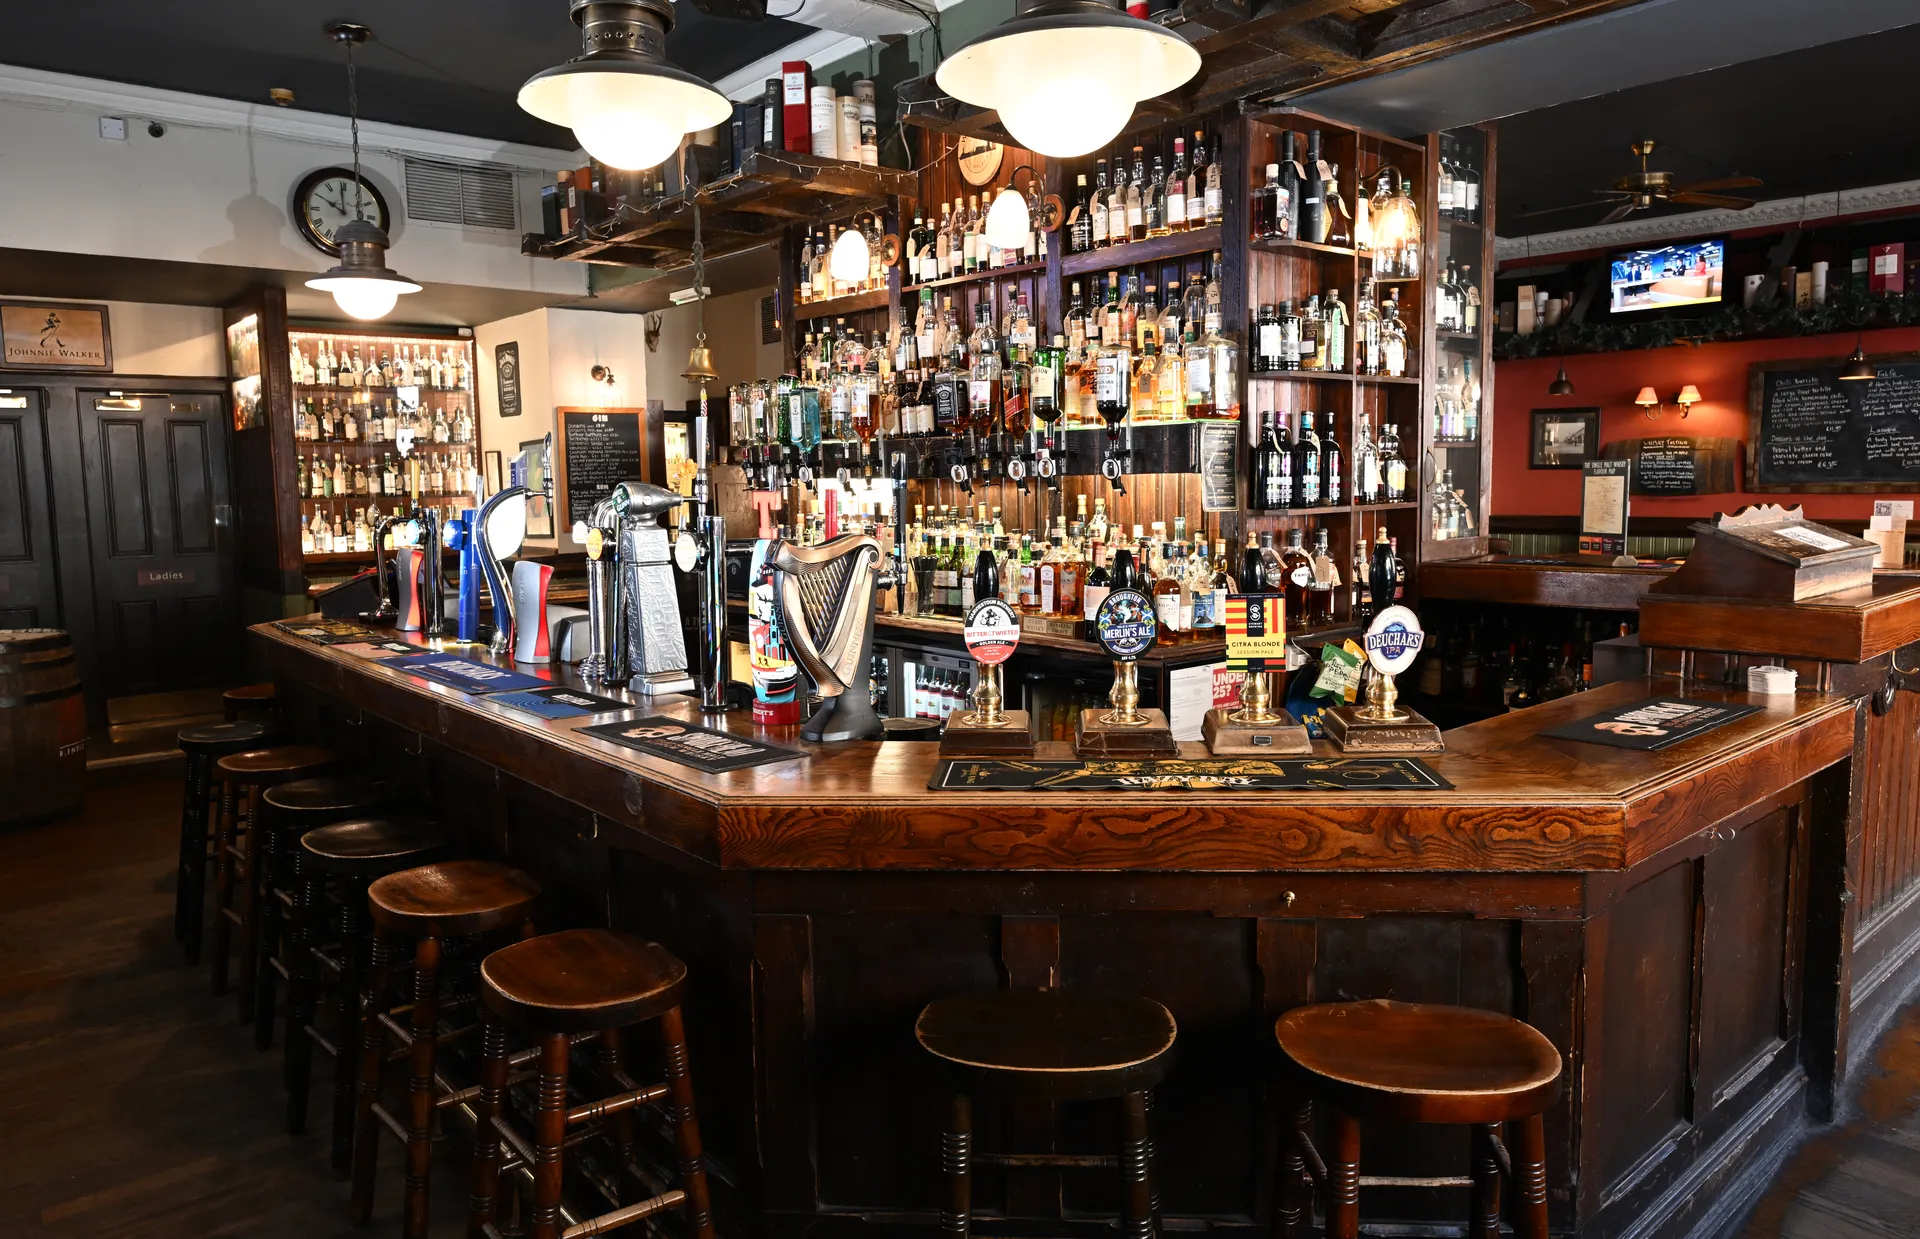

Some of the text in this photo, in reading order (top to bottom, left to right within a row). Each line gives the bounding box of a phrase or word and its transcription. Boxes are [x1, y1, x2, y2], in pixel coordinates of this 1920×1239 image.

[9, 348, 100, 358] JOHNNIE WALKER
[150, 572, 183, 580] Ladies
[1108, 593, 1142, 606] BROUGHTON
[1104, 626, 1151, 639] MERLIN'S ALE
[1369, 633, 1420, 649] DEUCHARS
[842, 618, 864, 678] GUINNESS
[1213, 685, 1232, 699] 25?
